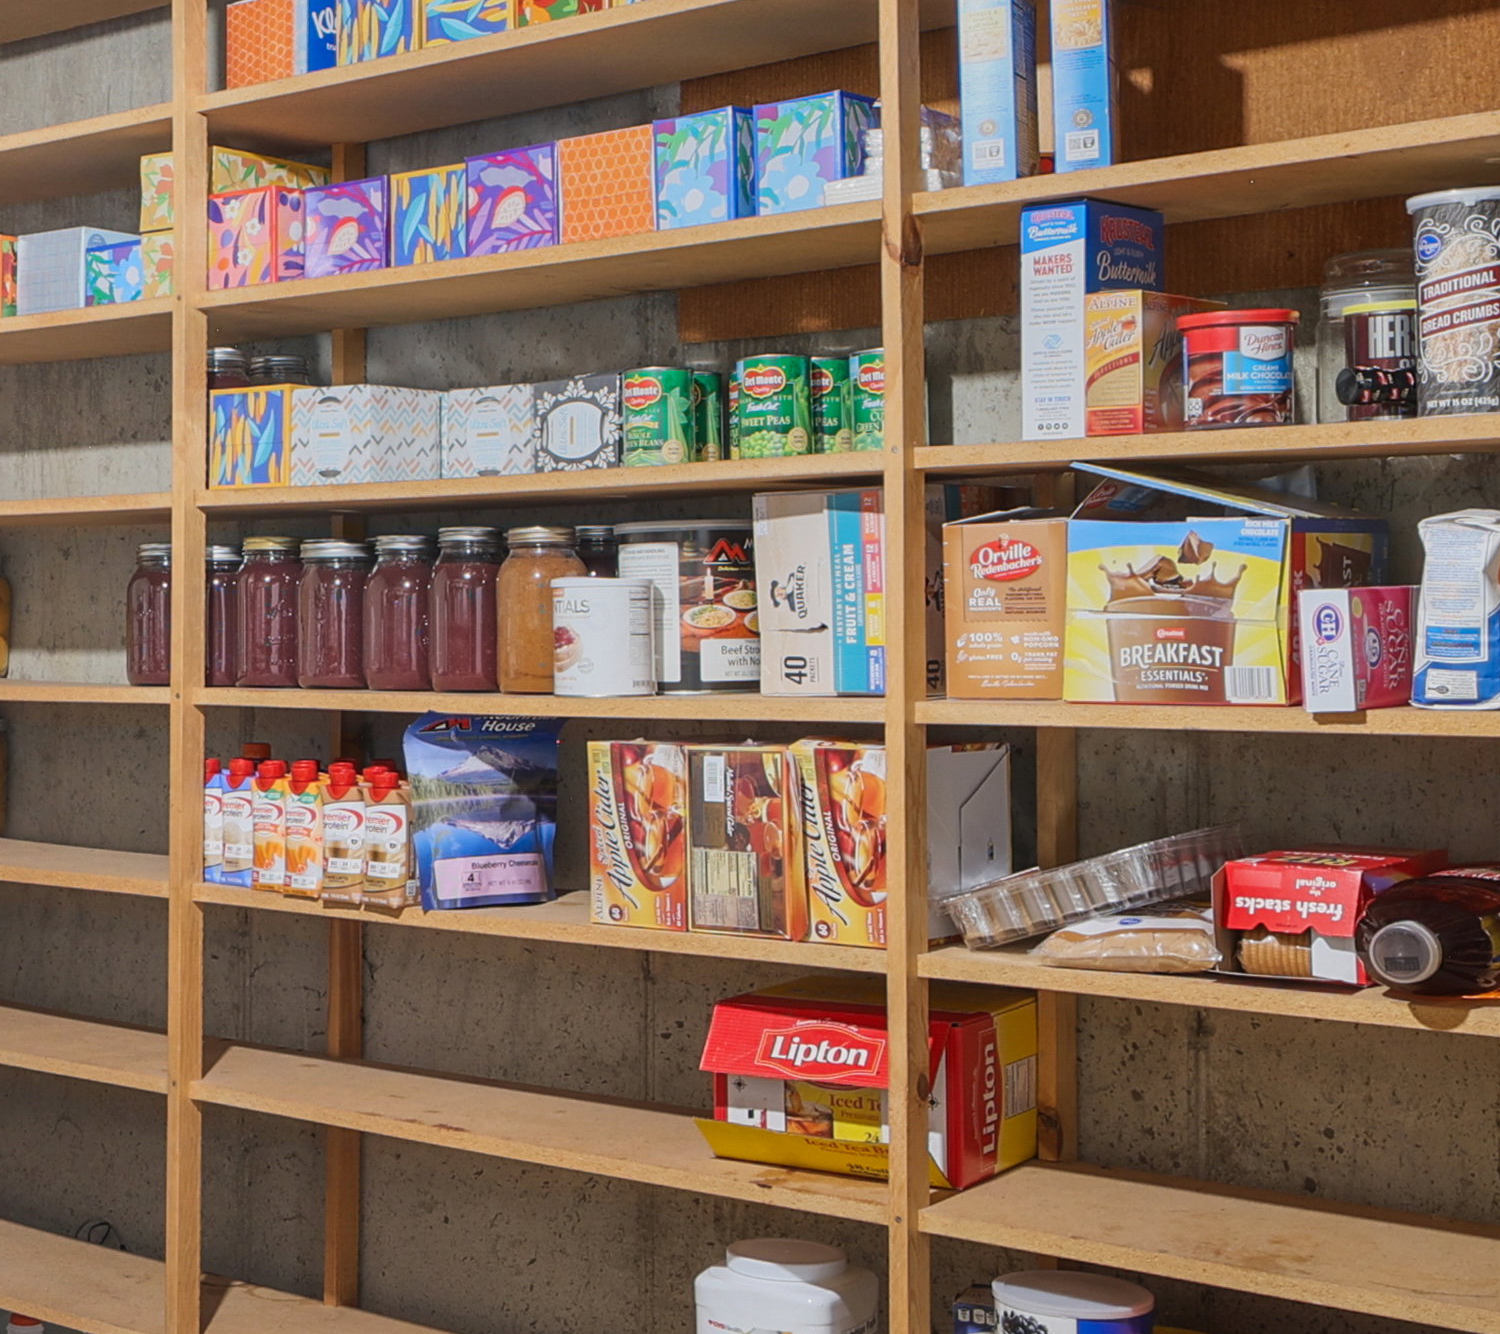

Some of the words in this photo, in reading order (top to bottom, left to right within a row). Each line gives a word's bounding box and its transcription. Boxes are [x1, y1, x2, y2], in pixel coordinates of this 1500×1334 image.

[1033, 254, 1072, 266] MAKERS
[1033, 264, 1072, 276] WANTED
[1423, 270, 1497, 300] TRADITIONAL
[1423, 315, 1450, 334] BREAD
[1453, 303, 1500, 324] CRUMBS
[744, 376, 755, 385] Del
[756, 373, 784, 385] Monte
[767, 415, 790, 426] PEAS
[979, 543, 1031, 565] Orville
[844, 544, 854, 588] CREAM
[797, 565, 807, 619] QUAKER
[846, 591, 855, 601] &
[969, 597, 1001, 607] REAL
[846, 605, 857, 644] FRUIT
[1121, 643, 1223, 668] BREAKFAST
[784, 656, 807, 685] 40
[1141, 670, 1203, 683] ESSENTIALS
[481, 720, 536, 733] House
[618, 802, 633, 850] ORIGINAL
[824, 810, 840, 862] ORIGINAL
[1236, 895, 1290, 913] stacks
[1297, 899, 1343, 921] fresh
[770, 1035, 869, 1068] Lipton
[980, 1042, 995, 1156] Lipton
